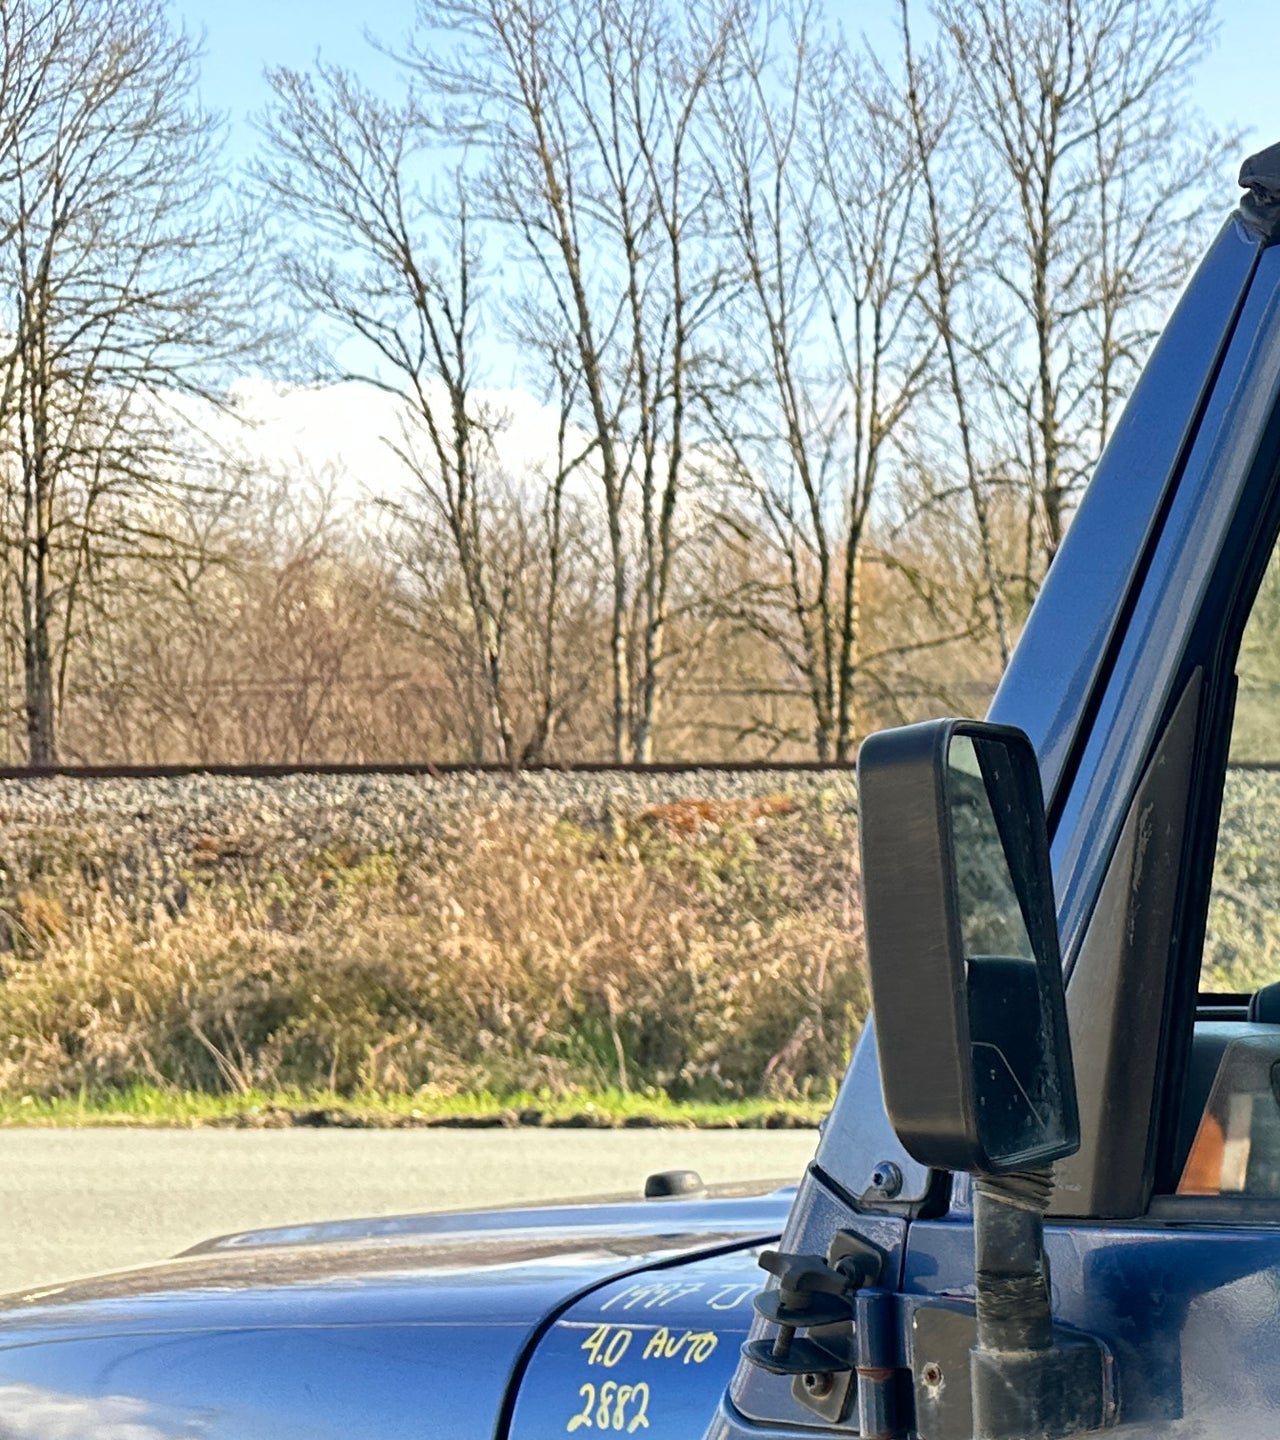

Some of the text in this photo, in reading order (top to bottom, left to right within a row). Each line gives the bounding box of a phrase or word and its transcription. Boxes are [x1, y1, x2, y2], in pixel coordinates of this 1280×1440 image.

[600, 1282, 764, 1312] 1997 TJ
[580, 1323, 719, 1368] 4.0 AUTO
[566, 1380, 650, 1434] 2882
